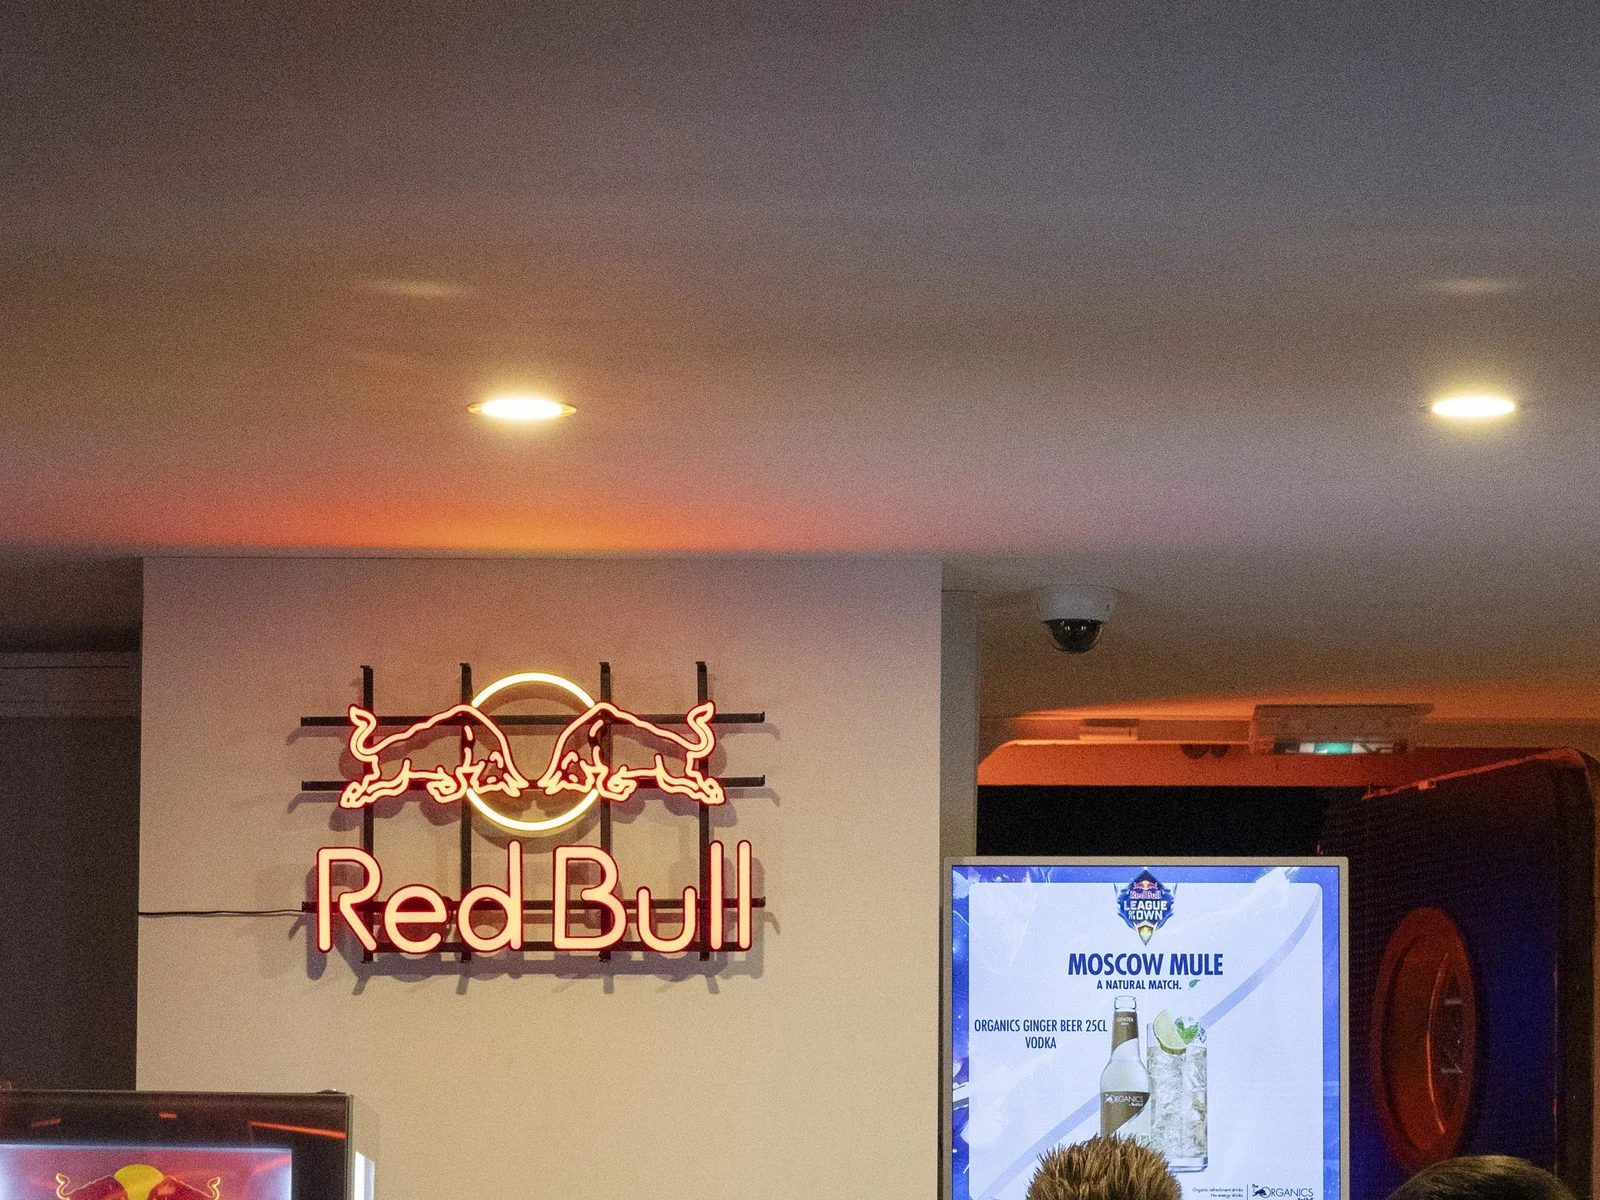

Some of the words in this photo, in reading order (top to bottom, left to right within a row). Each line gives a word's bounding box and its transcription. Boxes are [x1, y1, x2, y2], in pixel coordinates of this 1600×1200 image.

[316, 840, 523, 954] Red
[552, 840, 753, 954] Bull
[1130, 890, 1144, 899] Red
[1146, 890, 1161, 899] Bull
[1124, 900, 1168, 911] LEAGUE
[1136, 911, 1163, 920] OWN
[1068, 953, 1164, 976] MOSCOW
[1169, 953, 1224, 976] MULE
[1096, 980, 1103, 990] A
[1105, 980, 1146, 990] NATURAL
[1148, 980, 1182, 990] MATCH.
[974, 1019, 1021, 1032] ORGANICS
[1023, 1019, 1058, 1032] GINGER
[1060, 1019, 1083, 1032] BEER
[1085, 1019, 1108, 1032] 25CL
[1025, 1036, 1057, 1049] VODKA
[1260, 1186, 1314, 1198] ORGANICS
